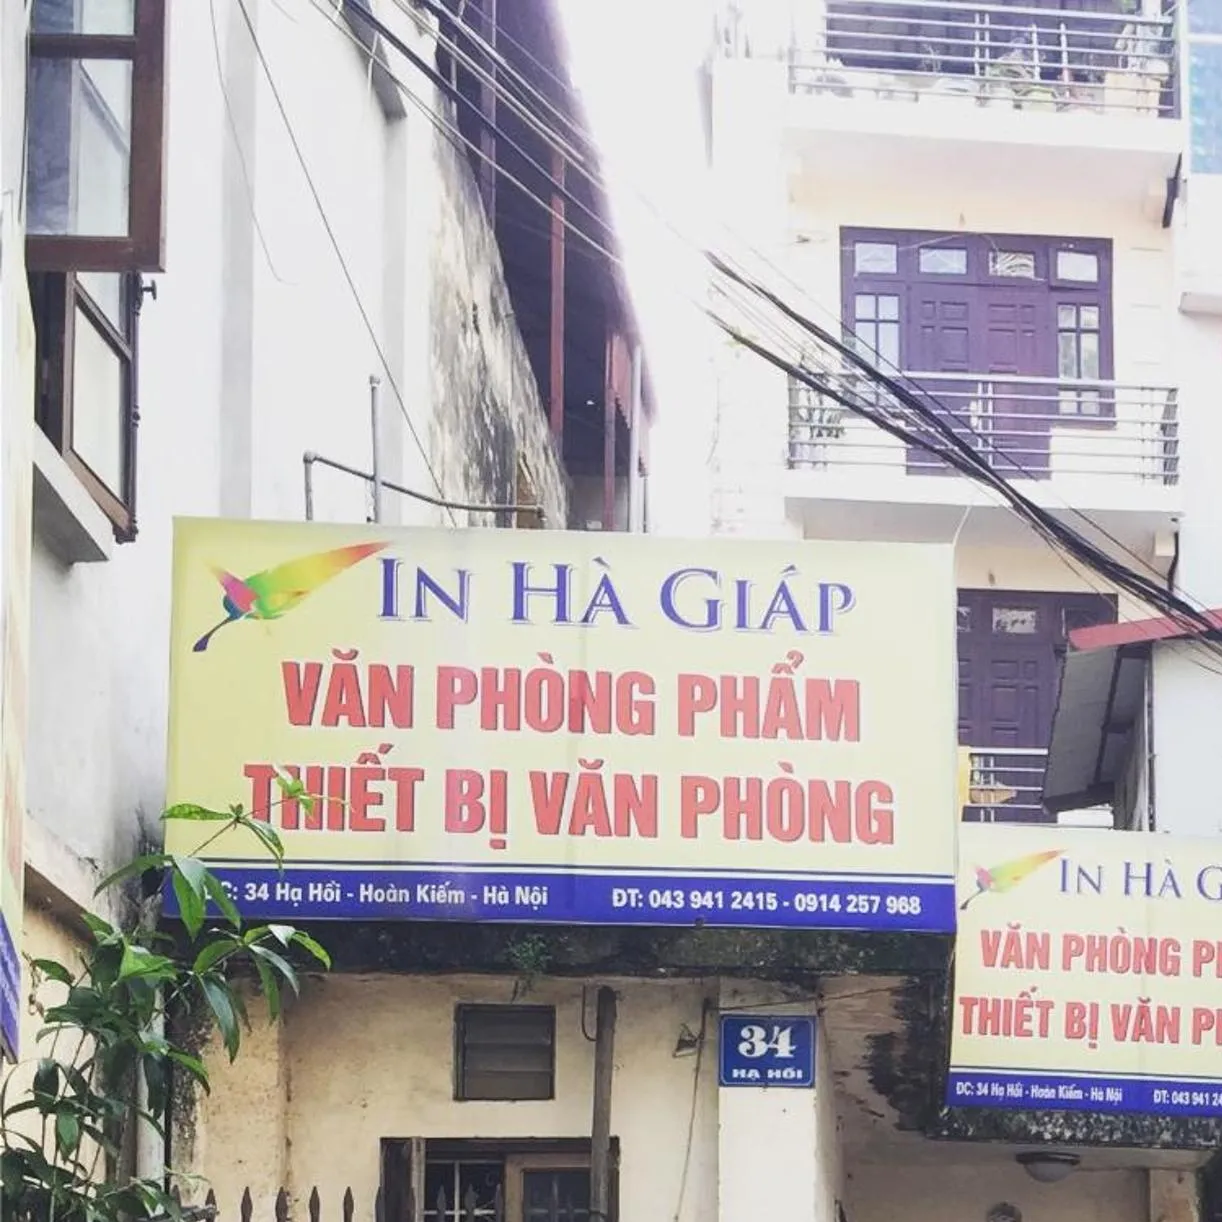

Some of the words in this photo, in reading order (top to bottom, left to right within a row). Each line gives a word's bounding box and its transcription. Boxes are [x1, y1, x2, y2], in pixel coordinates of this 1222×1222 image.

[509, 556, 634, 627] HÀ
[659, 563, 857, 636] GIÁP
[281, 648, 415, 730] VĂN
[435, 651, 656, 738] PHÒNG
[677, 650, 861, 743] PHẨM
[244, 743, 424, 834] THIẾT
[445, 768, 508, 850] BỊ
[529, 757, 662, 838] VĂN
[680, 762, 895, 846] PHÒNG
[244, 883, 269, 901] 34
[276, 882, 301, 907] Hạ
[309, 879, 341, 903] Hồi
[360, 883, 410, 904] Hoàn
[417, 880, 465, 905] Kiếm
[484, 885, 509, 906] Hà
[515, 885, 548, 911] Nội
[1124, 858, 1182, 898] HÀ
[612, 888, 643, 909] ĐT:
[648, 889, 684, 909] 043
[689, 891, 725, 910] 941
[730, 892, 778, 911] 2415
[794, 893, 841, 913] 0914
[846, 894, 880, 914] 257
[886, 895, 921, 915] 968
[980, 921, 1051, 970] VĂN
[1062, 925, 1181, 977] PHÒNG
[959, 986, 1054, 1038] THIẾT
[1064, 1002, 1100, 1049] BỊ
[1111, 996, 1181, 1045] VĂN
[738, 1025, 797, 1058] 34
[976, 1081, 989, 1096] 34
[1171, 1089, 1190, 1105] 043
[1192, 1090, 1209, 1106] 941
